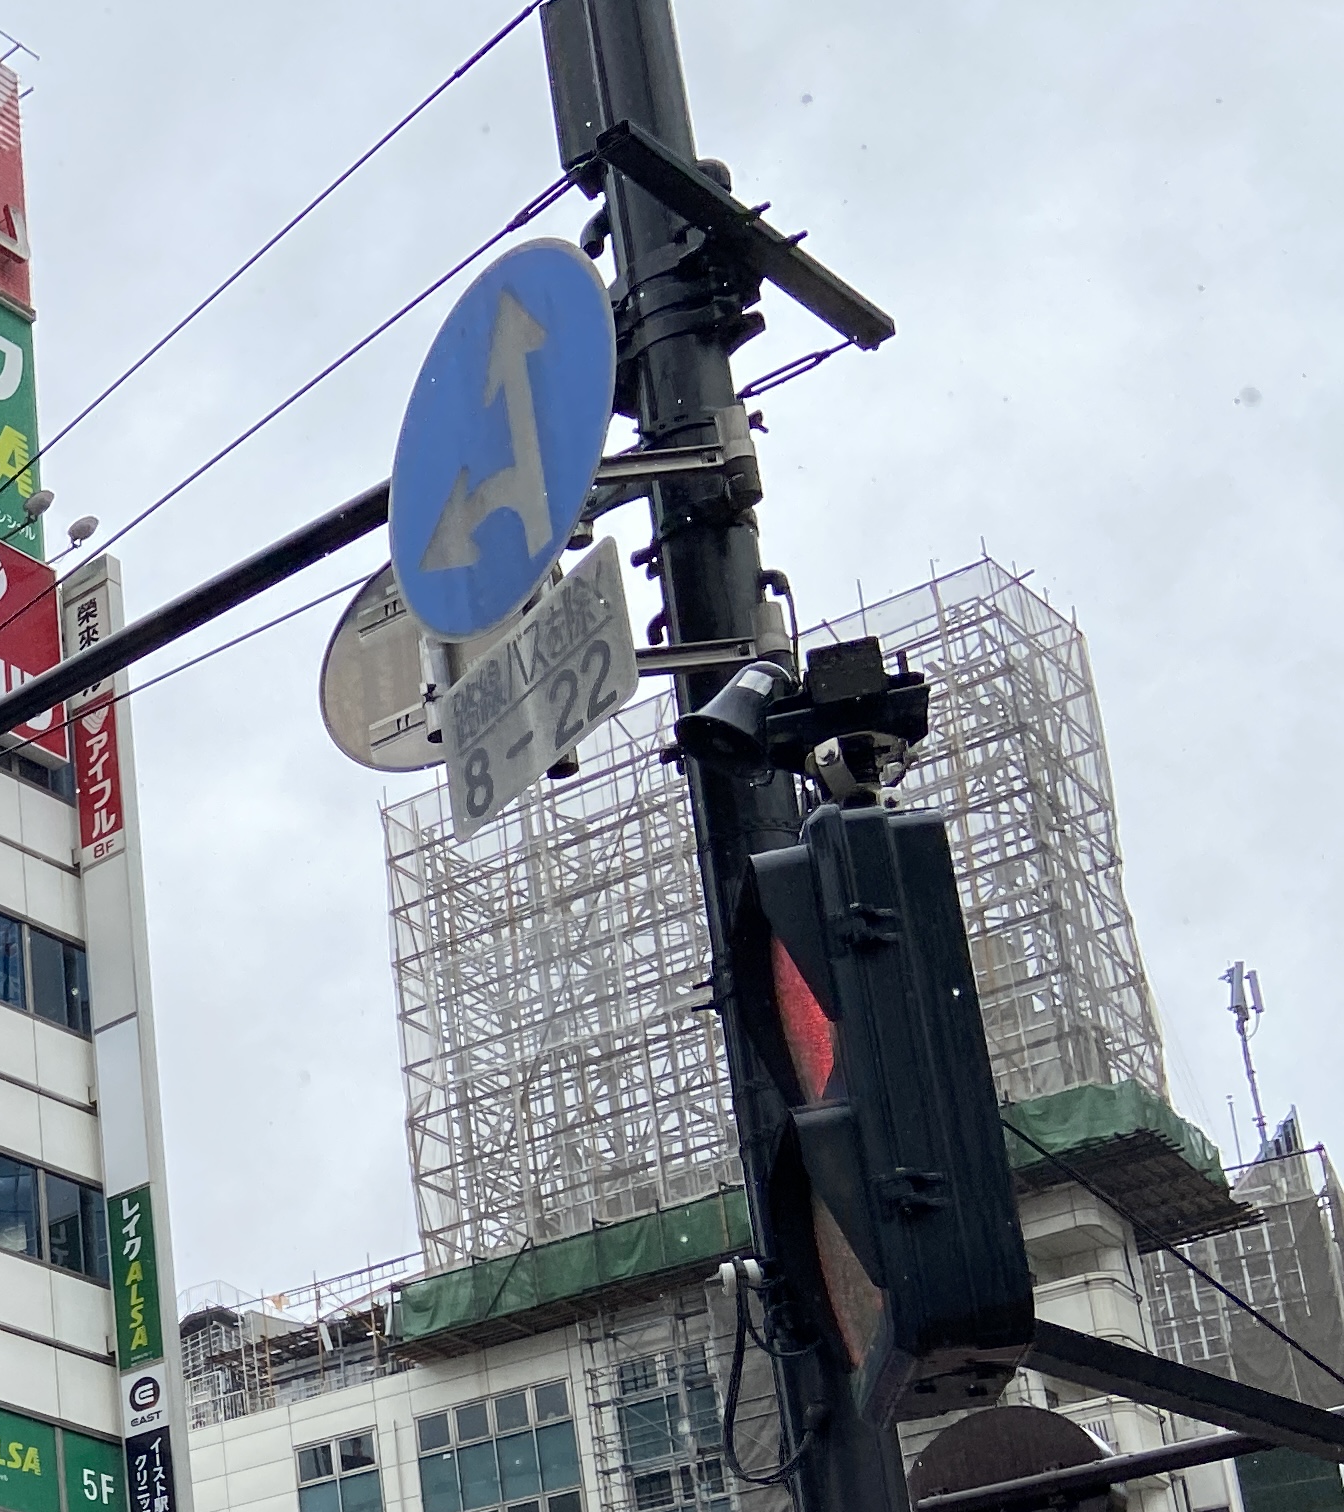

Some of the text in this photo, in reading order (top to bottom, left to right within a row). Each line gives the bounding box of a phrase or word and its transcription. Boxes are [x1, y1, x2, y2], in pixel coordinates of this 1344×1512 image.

[85, 731, 116, 839] アイフル
[94, 838, 115, 860] 8F
[121, 1196, 142, 1261] レイク
[125, 1261, 148, 1351] ALSA
[130, 1410, 163, 1428] EAST
[82, 1468, 114, 1505] 5F
